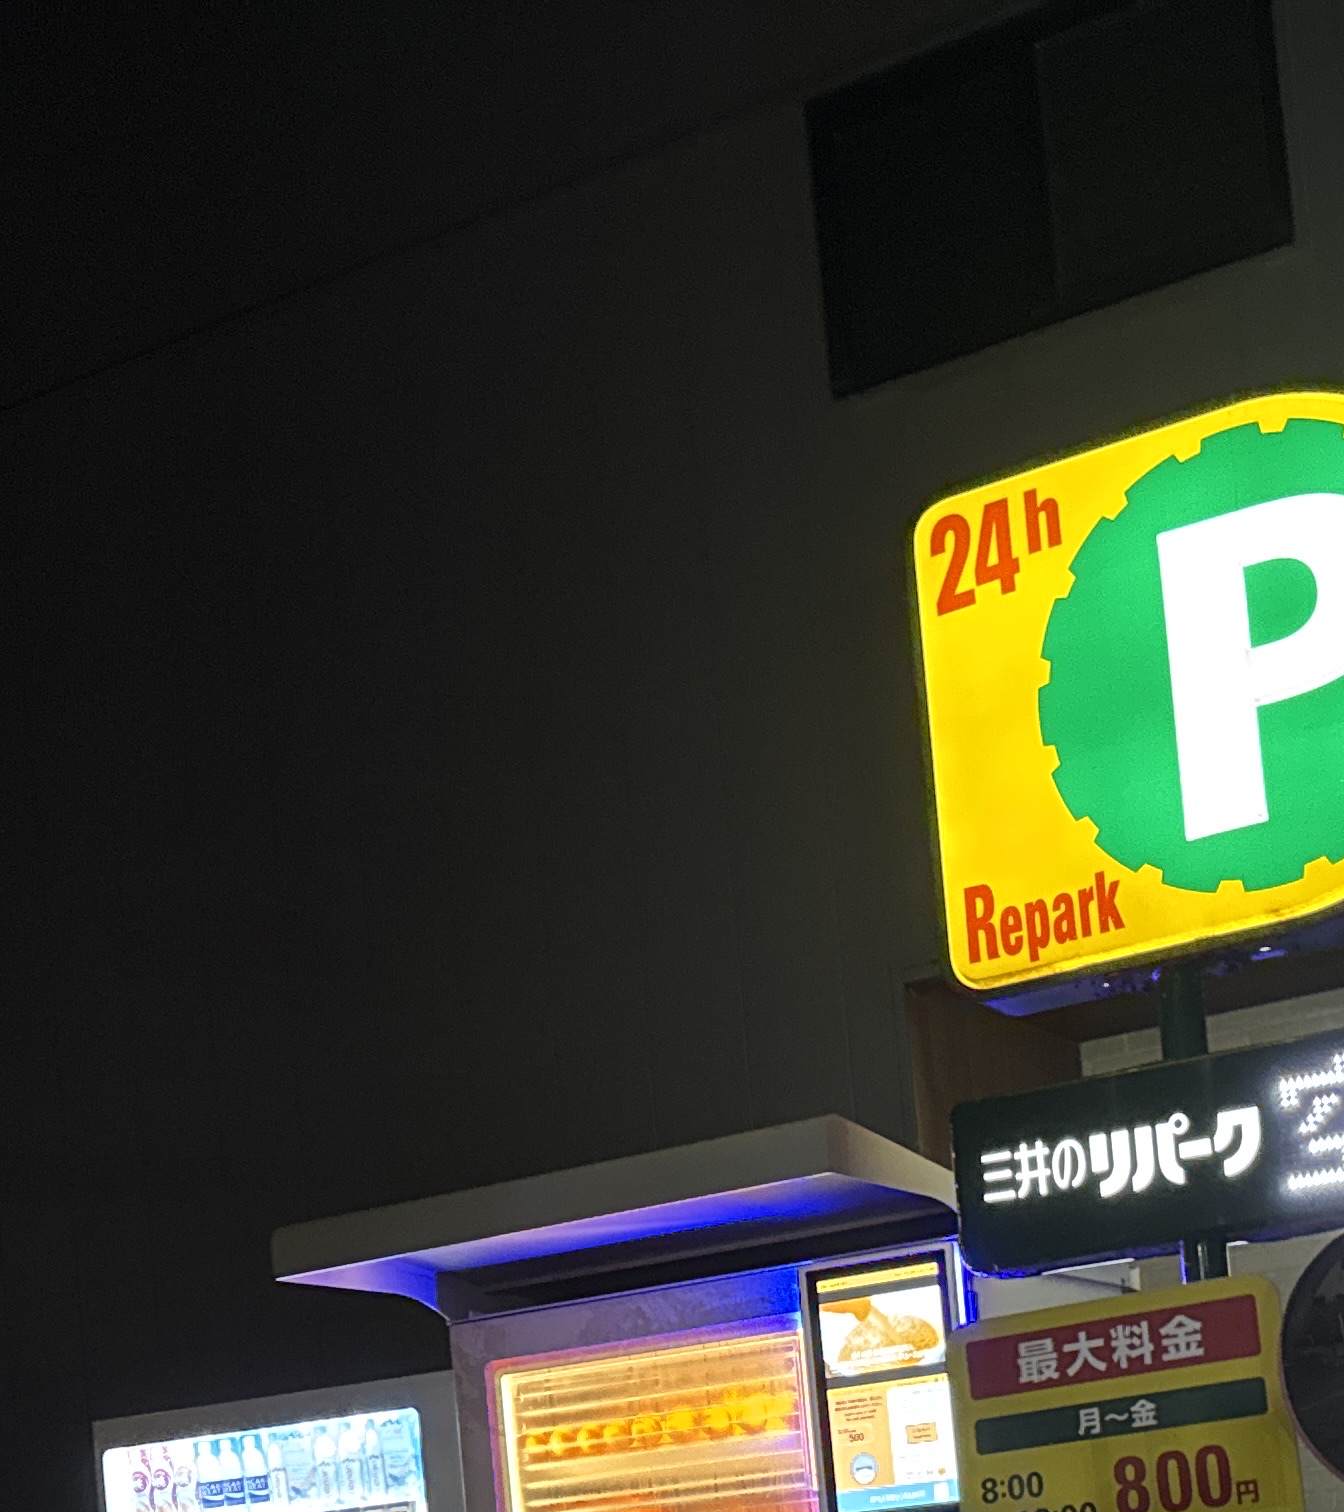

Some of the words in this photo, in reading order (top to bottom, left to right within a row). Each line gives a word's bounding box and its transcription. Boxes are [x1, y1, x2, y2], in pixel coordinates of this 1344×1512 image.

[929, 488, 1062, 617] 24h
[963, 871, 1126, 963] Repark
[981, 1106, 1262, 1202] 三井のリパーク
[1017, 1314, 1205, 1384] 最大料金
[981, 1472, 1044, 1503] 8:00
